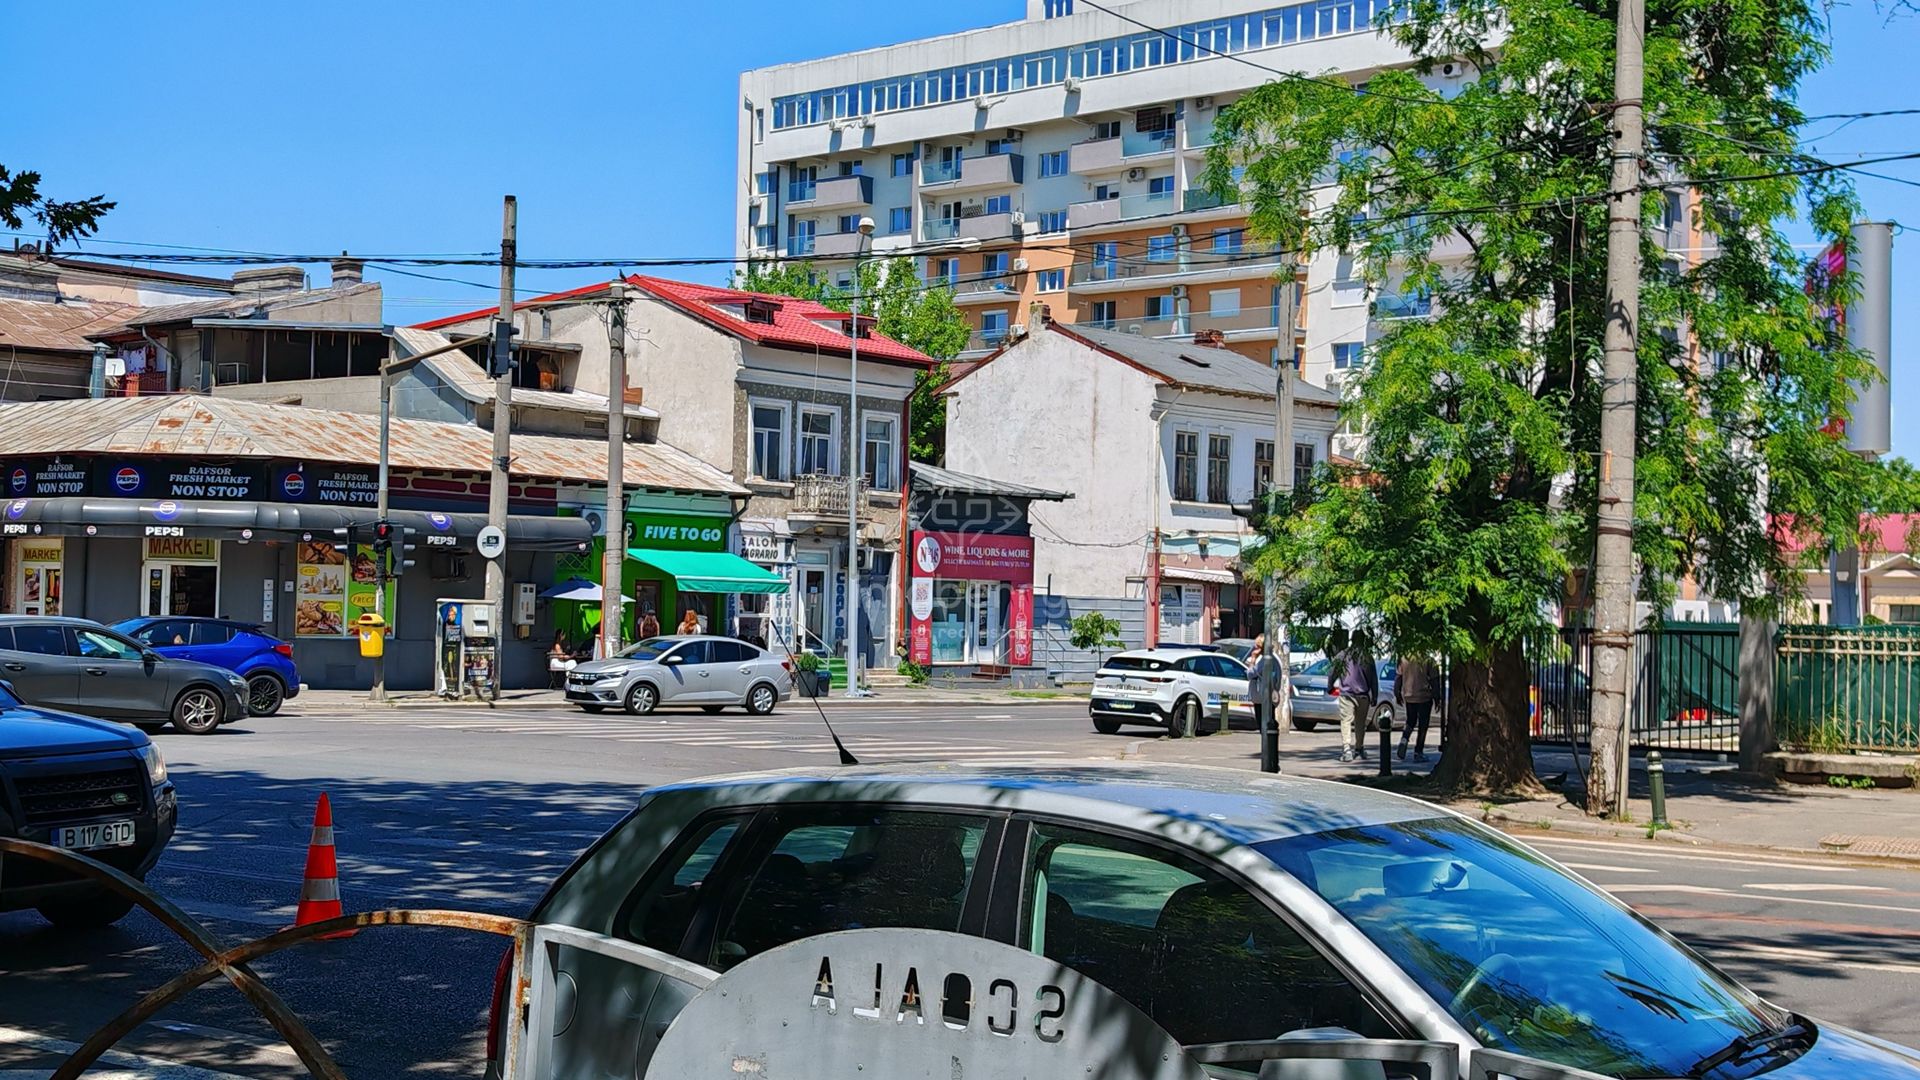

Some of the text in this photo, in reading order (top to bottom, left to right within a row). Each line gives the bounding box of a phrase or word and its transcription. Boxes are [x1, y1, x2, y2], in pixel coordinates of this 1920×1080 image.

[47, 464, 74, 472] RAFSOR
[188, 466, 232, 475] RAFSOR
[35, 471, 86, 480] FRESH MARKET
[169, 473, 251, 484] FRESH MARKET
[334, 472, 369, 481] RAFSOR
[37, 482, 84, 493] NON STOP
[318, 479, 380, 489] FRESH MARKE
[171, 485, 249, 497] NON STOP
[320, 490, 348, 501] NON
[3, 524, 27, 534] PEPSI
[145, 526, 184, 537] PEPSI
[644, 525, 722, 542] FIVE TO GO
[427, 535, 457, 546] PEPSI
[741, 536, 778, 548] SALON
[149, 538, 211, 556] MARKET
[24, 549, 62, 560] MARKET
[966, 547, 1000, 559] LIQUORS
[1000, 550, 1008, 558] &
[1008, 549, 1030, 559] MORE
[64, 823, 131, 847] B 117 GTD
